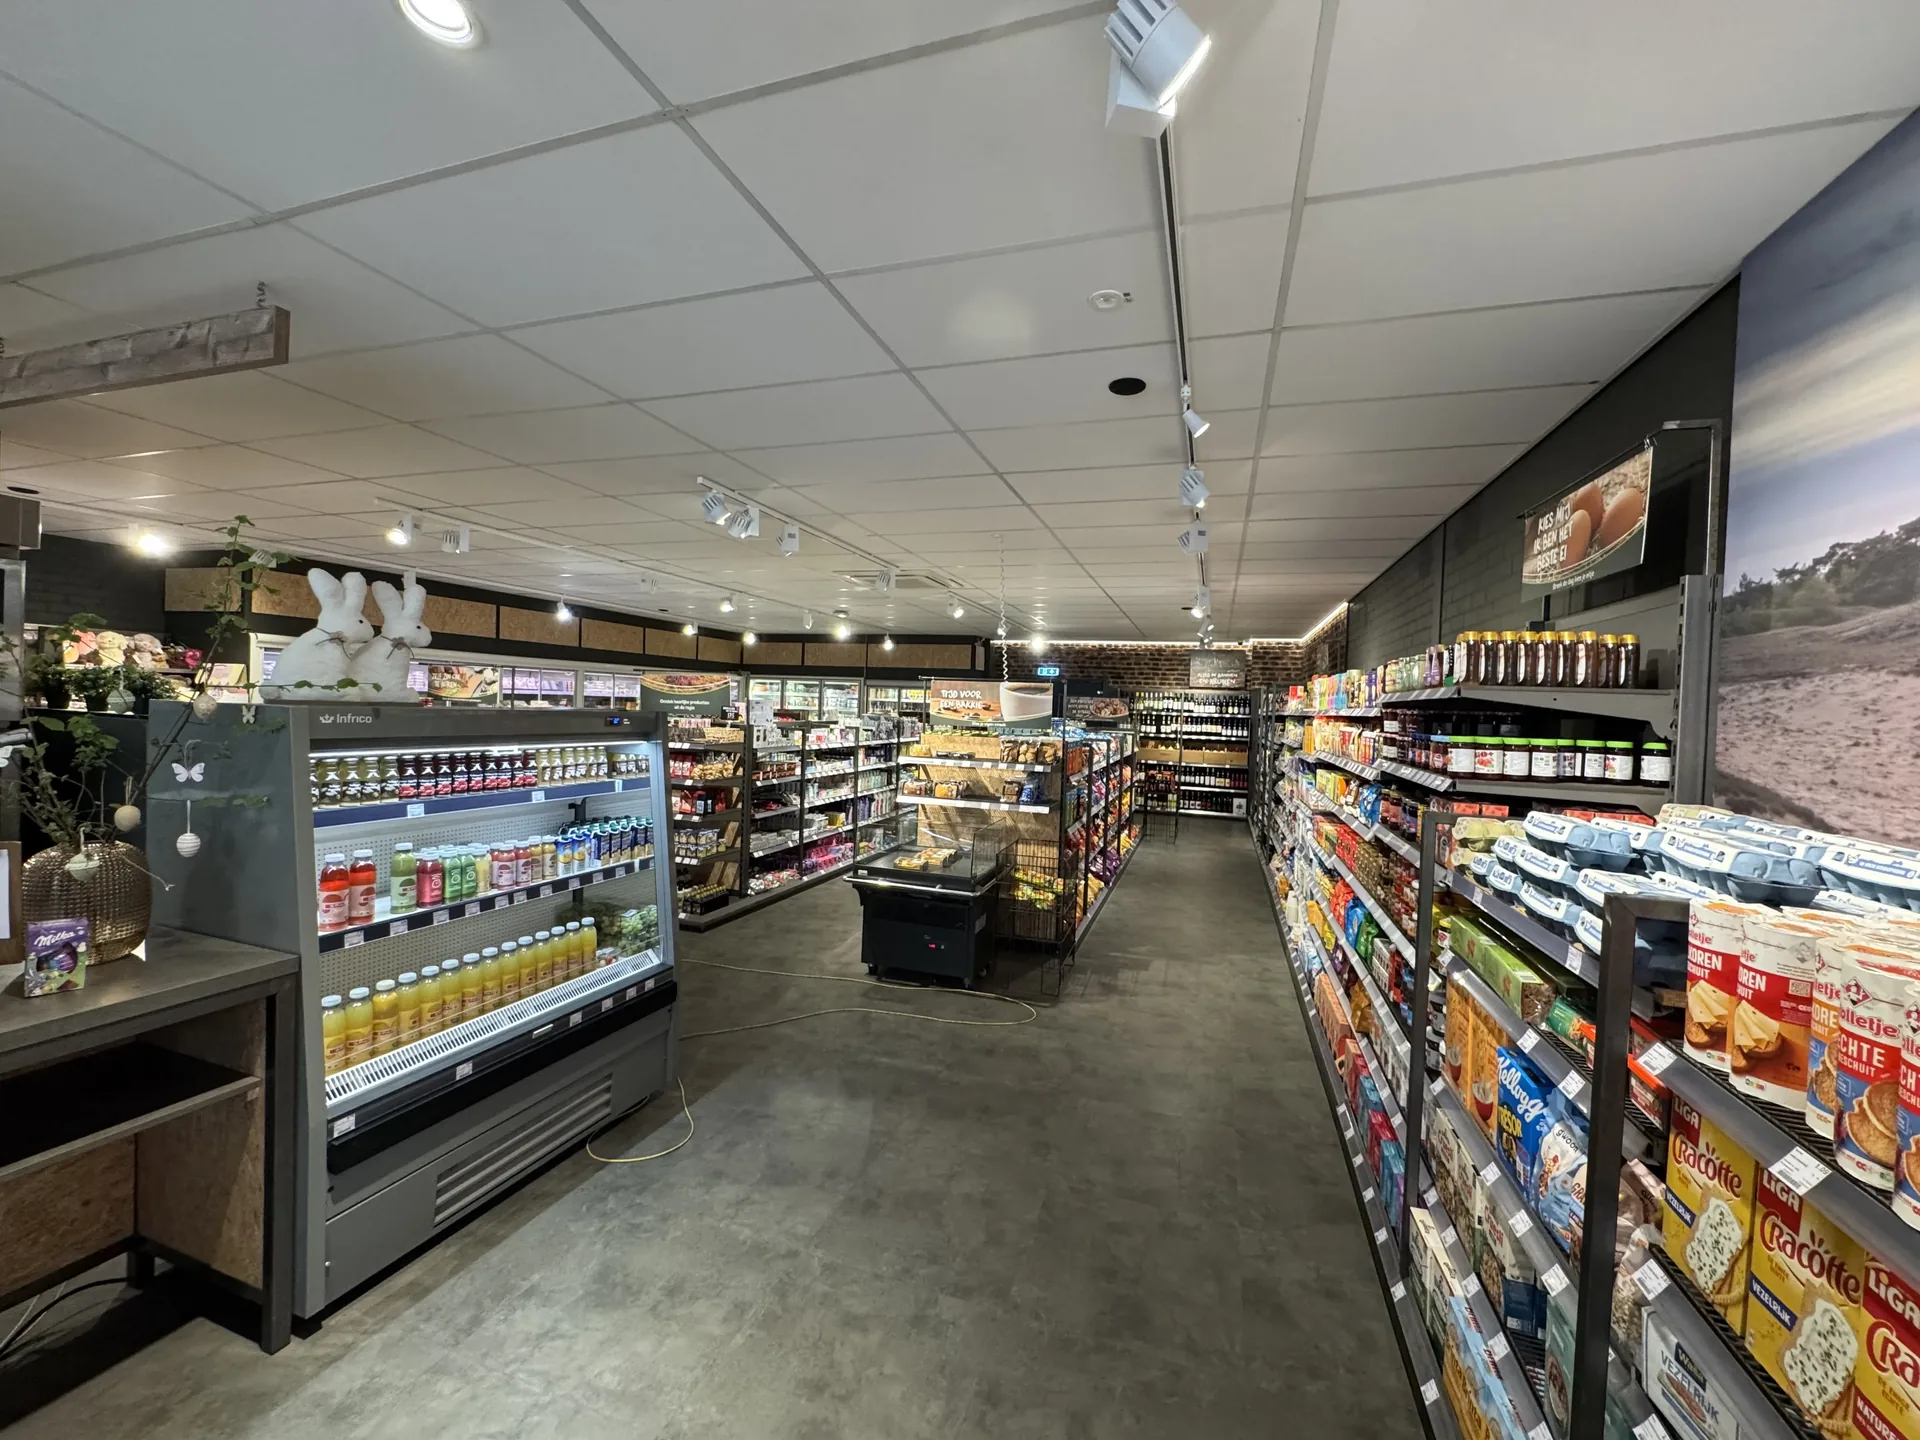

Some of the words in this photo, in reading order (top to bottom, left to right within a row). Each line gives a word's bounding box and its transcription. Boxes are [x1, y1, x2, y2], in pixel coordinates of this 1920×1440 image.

[1538, 512, 1554, 536] KIES
[1556, 504, 1571, 523] MIJ
[1533, 537, 1542, 555] IK
[1542, 528, 1558, 550] BEN
[1558, 520, 1574, 542] HET
[1536, 549, 1559, 573] BESTE
[1559, 544, 1568, 562] EI
[940, 689, 958, 699] TIJD
[960, 690, 982, 700] VOOR
[955, 700, 983, 710] BAKKIE
[34, 931, 76, 947] Milka
[1555, 1128, 1581, 1154] gwoon
[1814, 1162, 1830, 1176] 1.09
[1751, 1279, 1792, 1328] VEZELRIJK
